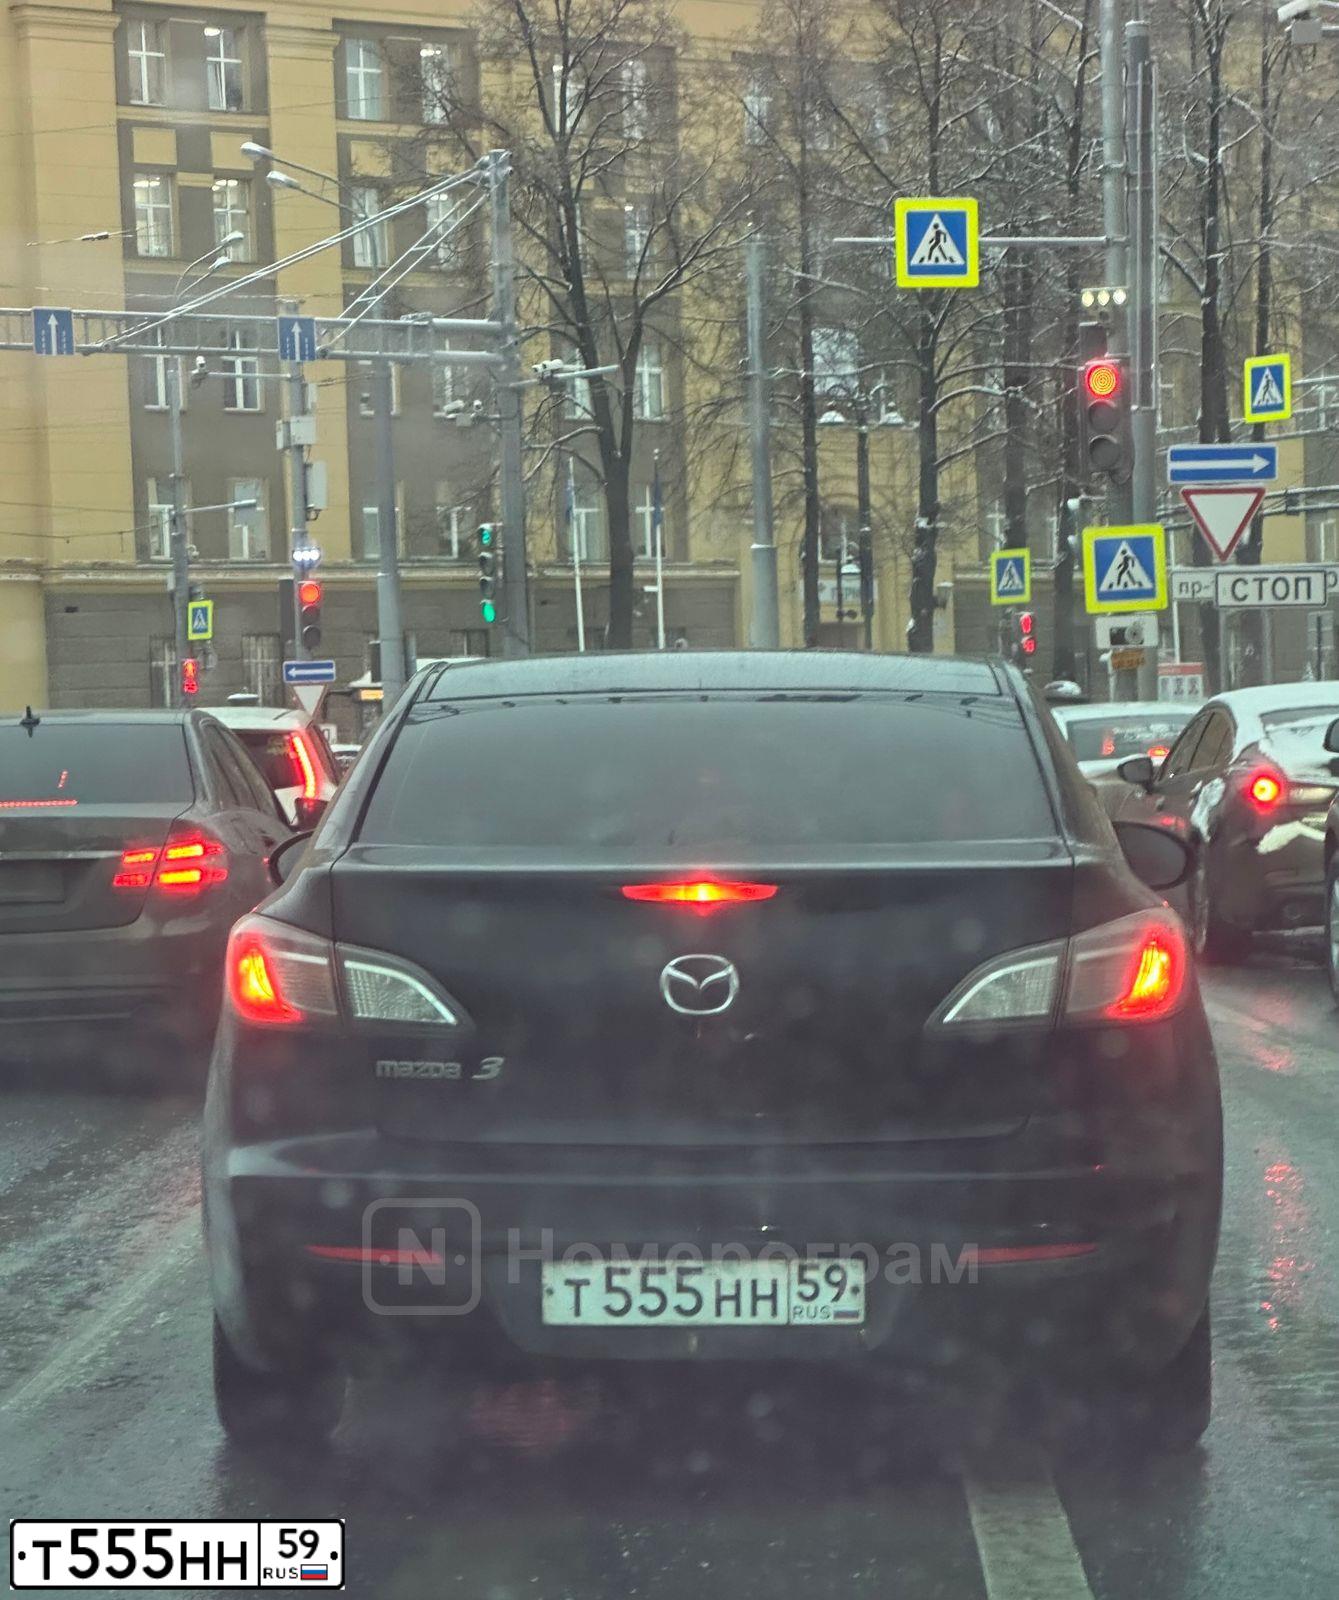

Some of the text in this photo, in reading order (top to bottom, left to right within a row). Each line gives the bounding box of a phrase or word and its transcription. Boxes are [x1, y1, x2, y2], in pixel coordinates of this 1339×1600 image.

[1231, 576, 1312, 602] СТОП
[375, 1060, 462, 1079] mazda
[564, 1263, 848, 1318] Т555НН 59
[792, 1305, 831, 1321] RUS
